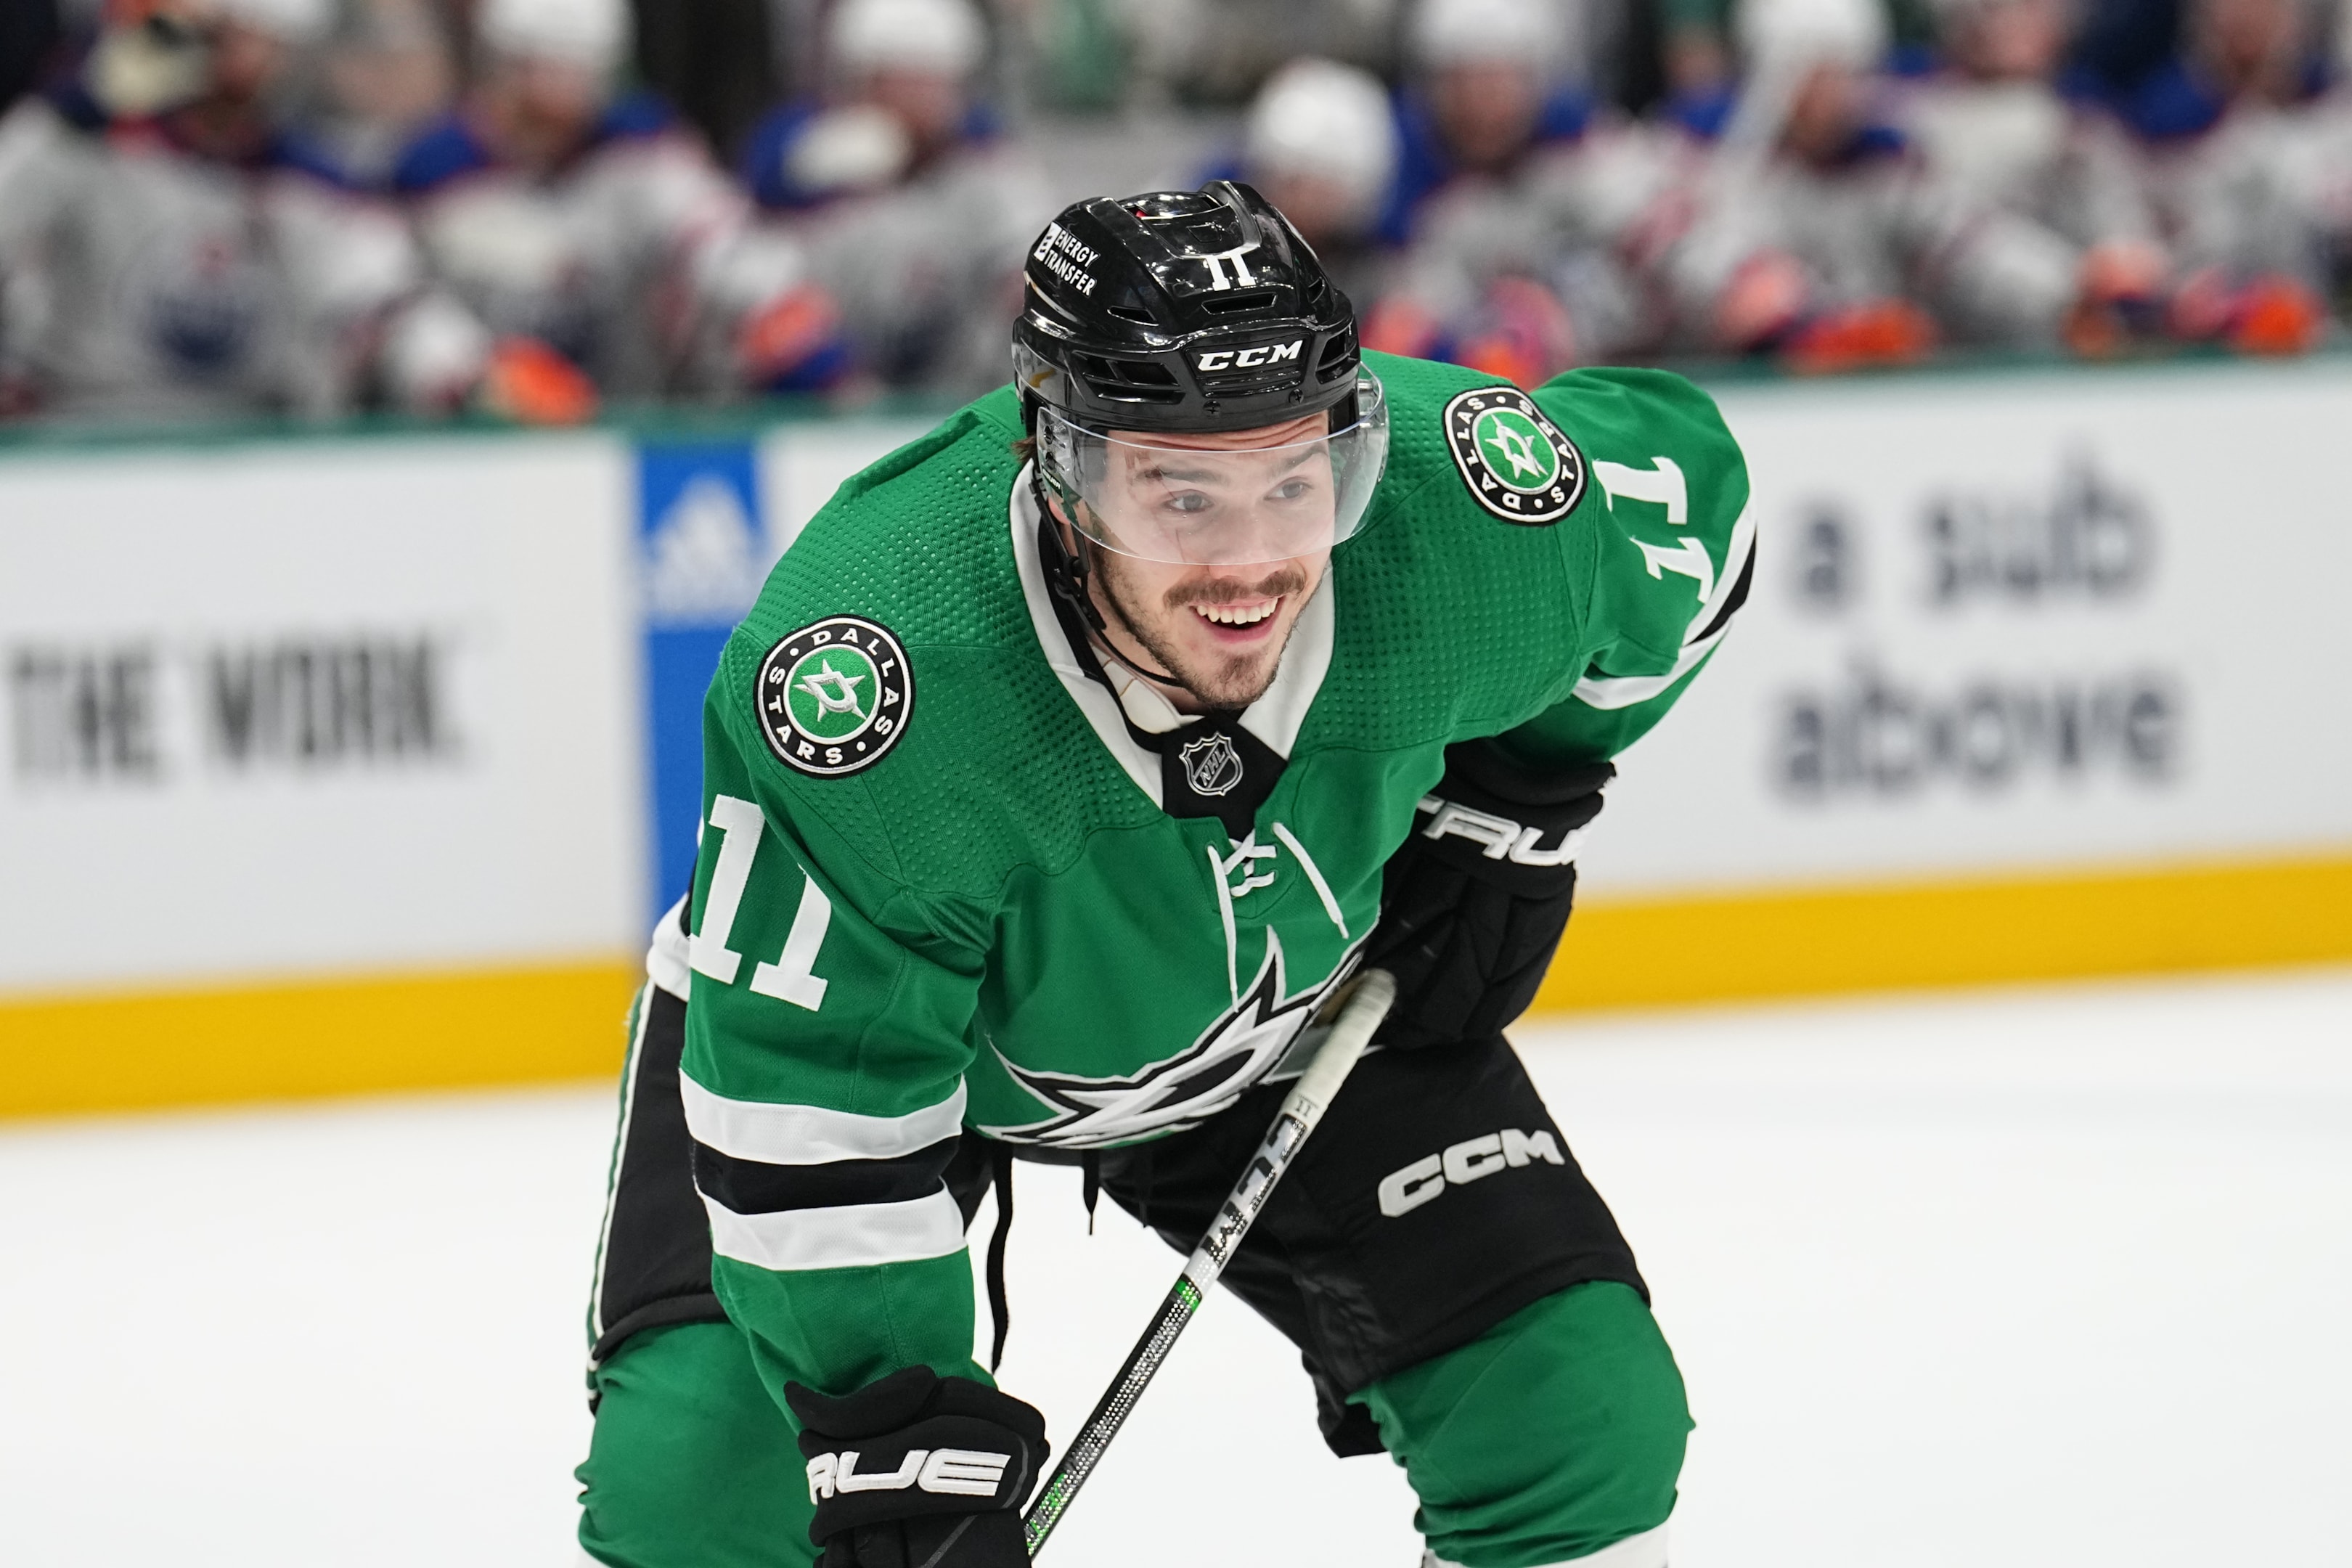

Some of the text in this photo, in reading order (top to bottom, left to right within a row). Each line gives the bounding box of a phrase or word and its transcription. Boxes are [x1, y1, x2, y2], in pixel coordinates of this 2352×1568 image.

[1044, 249, 1096, 296] TRANSFER
[1054, 229, 1099, 268] ENERGY
[1205, 249, 1257, 292] 11
[1197, 339, 1304, 372] CCM
[1456, 397, 1522, 511] DALLAS
[1518, 399, 1575, 504] STARS
[1592, 456, 1715, 605] 11
[1789, 444, 2156, 610] a sub
[13, 645, 161, 780] THE
[768, 666, 844, 765] STARS
[810, 627, 900, 736] DALLAS
[1773, 652, 2184, 793] above
[1200, 748, 1226, 786] NHL
[1416, 793, 1585, 866] RU
[689, 793, 832, 1012] 11
[1200, 1114, 1307, 1269] CCM
[1378, 1128, 1566, 1218] CCM
[806, 1447, 1012, 1506] RUE
